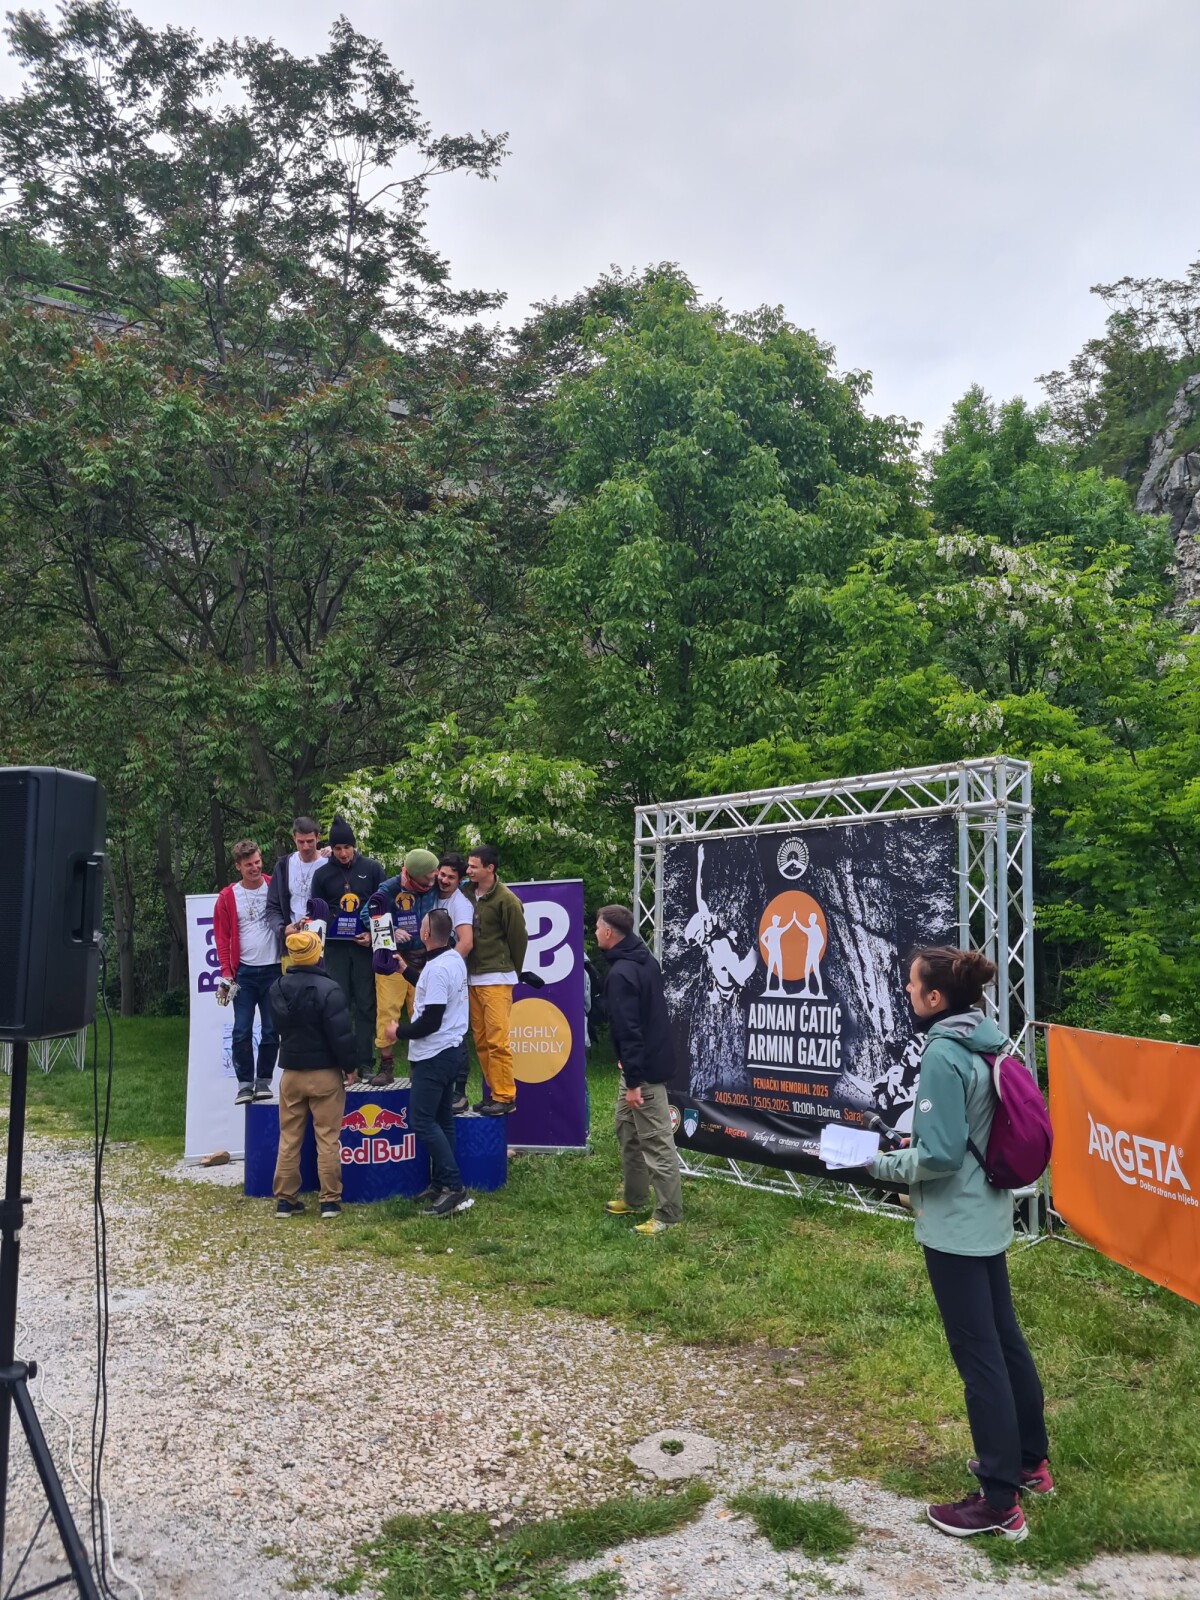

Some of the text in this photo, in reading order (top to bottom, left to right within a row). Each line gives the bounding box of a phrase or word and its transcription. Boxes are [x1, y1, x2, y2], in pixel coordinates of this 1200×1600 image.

[747, 1001, 842, 1034] ADNAN ĆATIĆ
[508, 1025, 558, 1038] HIGHLY
[509, 1041, 564, 1053] RIENDLY
[747, 1033, 842, 1068] ARMIN GAZIĆ
[753, 1077, 829, 1098] PENJAČKI MEMORIAL 2025
[792, 1101, 816, 1115] 10:00h
[844, 1107, 864, 1125] Saraj
[724, 1126, 748, 1138] ARGETA
[338, 1133, 415, 1164] ed Bull
[1087, 1111, 1191, 1190] ARGETA
[1140, 1179, 1199, 1207] Dobra strana hljeba
